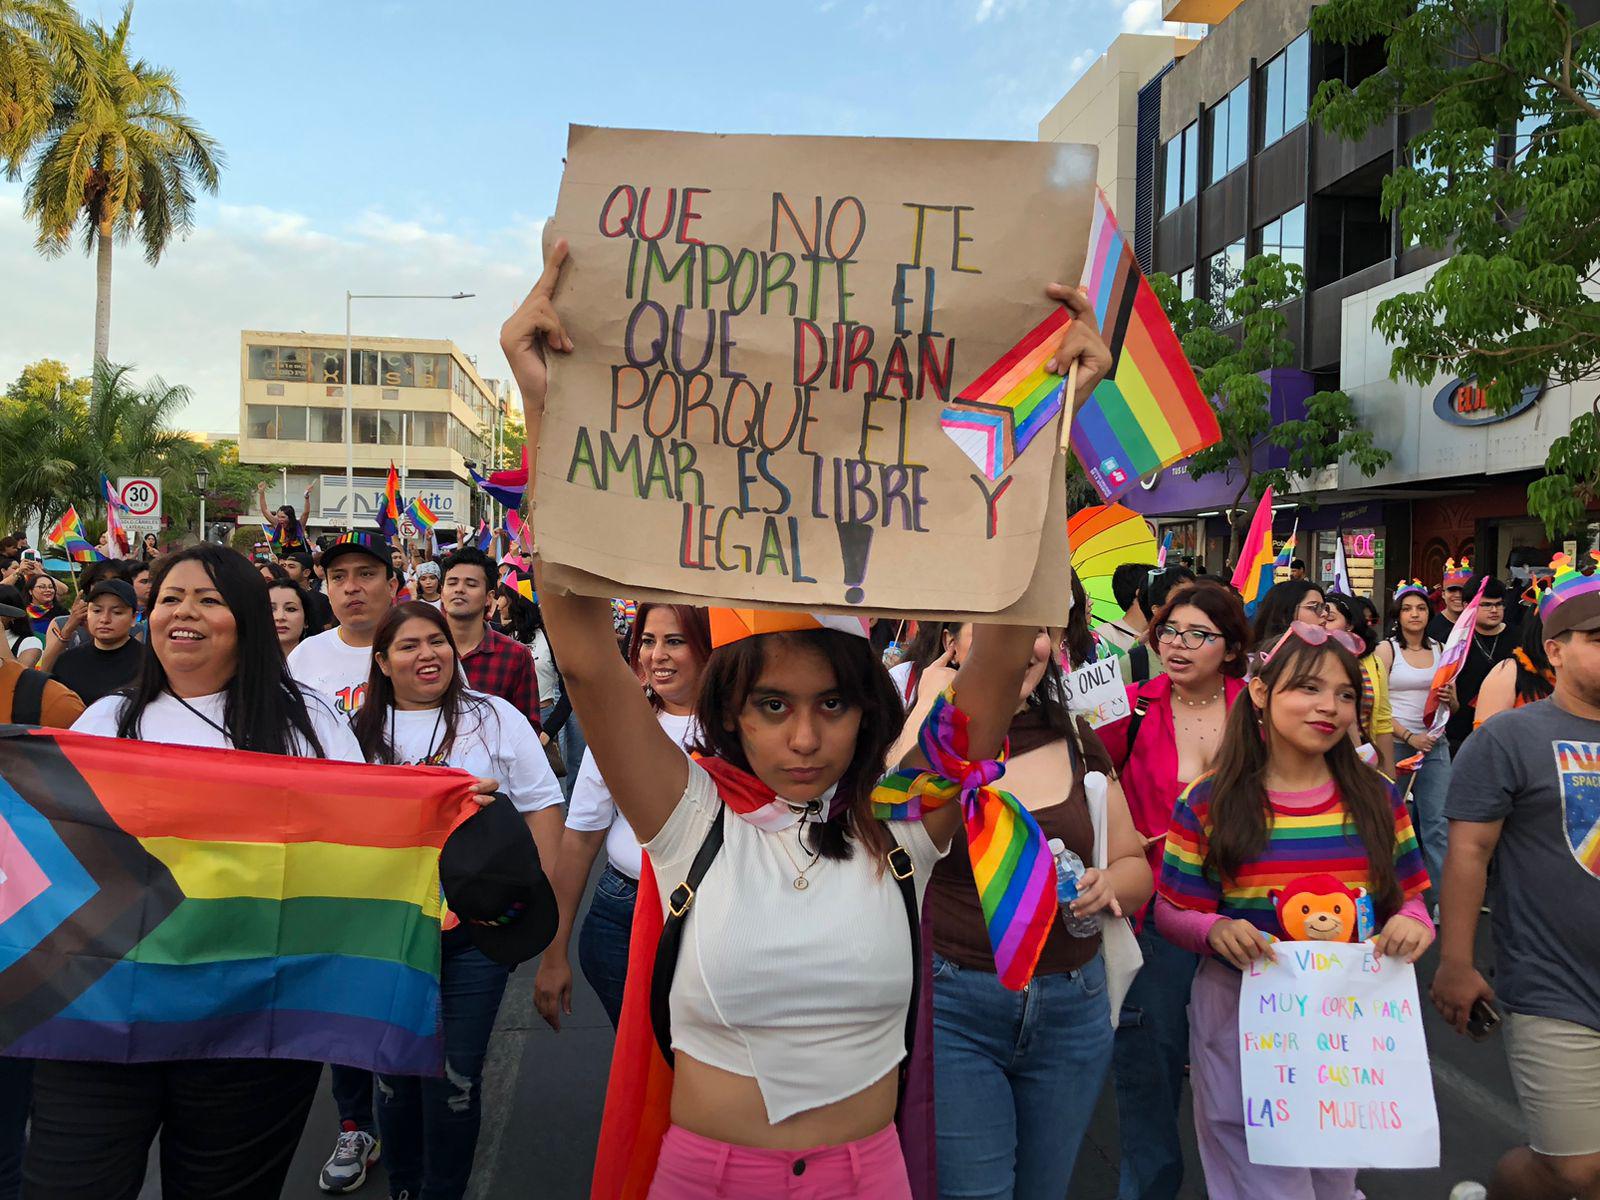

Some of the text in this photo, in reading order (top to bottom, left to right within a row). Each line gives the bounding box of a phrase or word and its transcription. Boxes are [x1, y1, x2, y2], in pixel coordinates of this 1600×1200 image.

[599, 185, 982, 274] QUE NO TE
[626, 239, 943, 337] IMPORTE EL
[626, 300, 747, 379] QUE
[611, 365, 929, 471] PORQUE EL
[130, 487, 148, 502] 30
[566, 427, 704, 505] AMAR
[737, 447, 793, 514] ES
[811, 454, 930, 532] LIBRE
[971, 476, 1013, 539] Y
[1079, 660, 1115, 694] ONLY
[1295, 950, 1343, 970] VIDA
[1362, 953, 1381, 973] ES
[1260, 993, 1412, 1023] MUY CORTA PARA
[1316, 1033, 1349, 1051] QUE
[1372, 1035, 1395, 1051] NO
[1274, 1064, 1384, 1087] TE GUSTAN
[1247, 1097, 1401, 1130] LAS MUJERES
